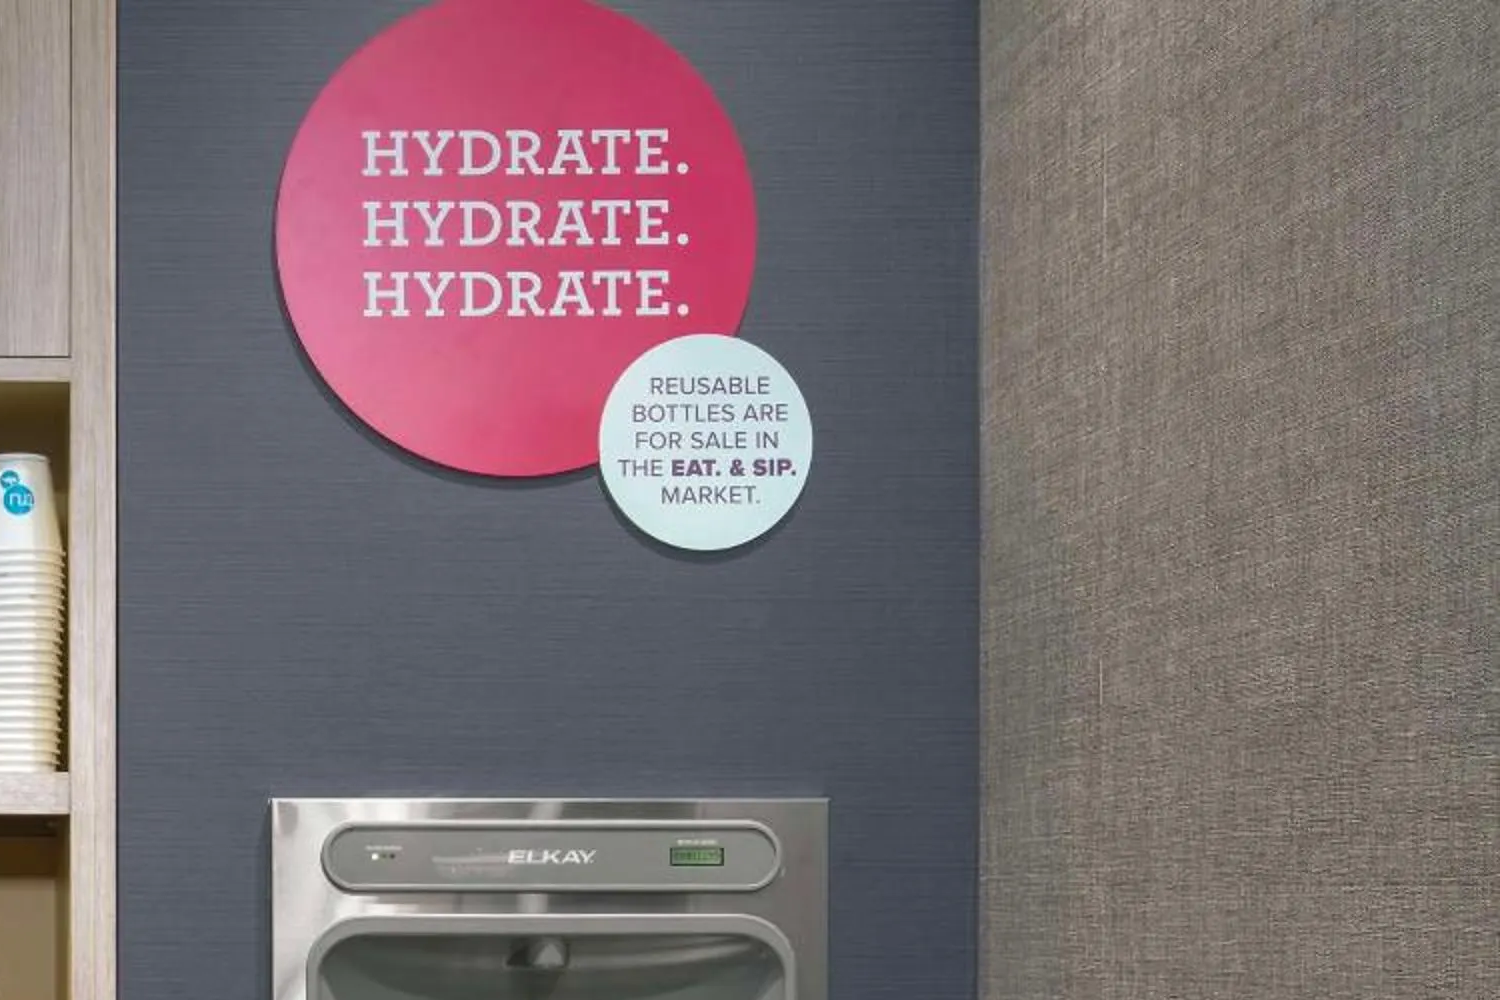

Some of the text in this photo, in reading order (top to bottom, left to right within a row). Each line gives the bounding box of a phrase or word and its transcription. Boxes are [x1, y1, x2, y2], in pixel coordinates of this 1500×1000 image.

[361, 129, 689, 176] HYDRATE.
[362, 200, 689, 247] HYDRATE.
[362, 270, 690, 317] HYDRATE.
[650, 376, 771, 395] REUSABLE
[632, 404, 789, 423] BOTTLES ARE
[635, 431, 779, 450] FOR SALE IN
[618, 458, 797, 477] THE EAT. & SIP.
[661, 485, 761, 505] MARKET.
[507, 849, 597, 865] ELKAY
